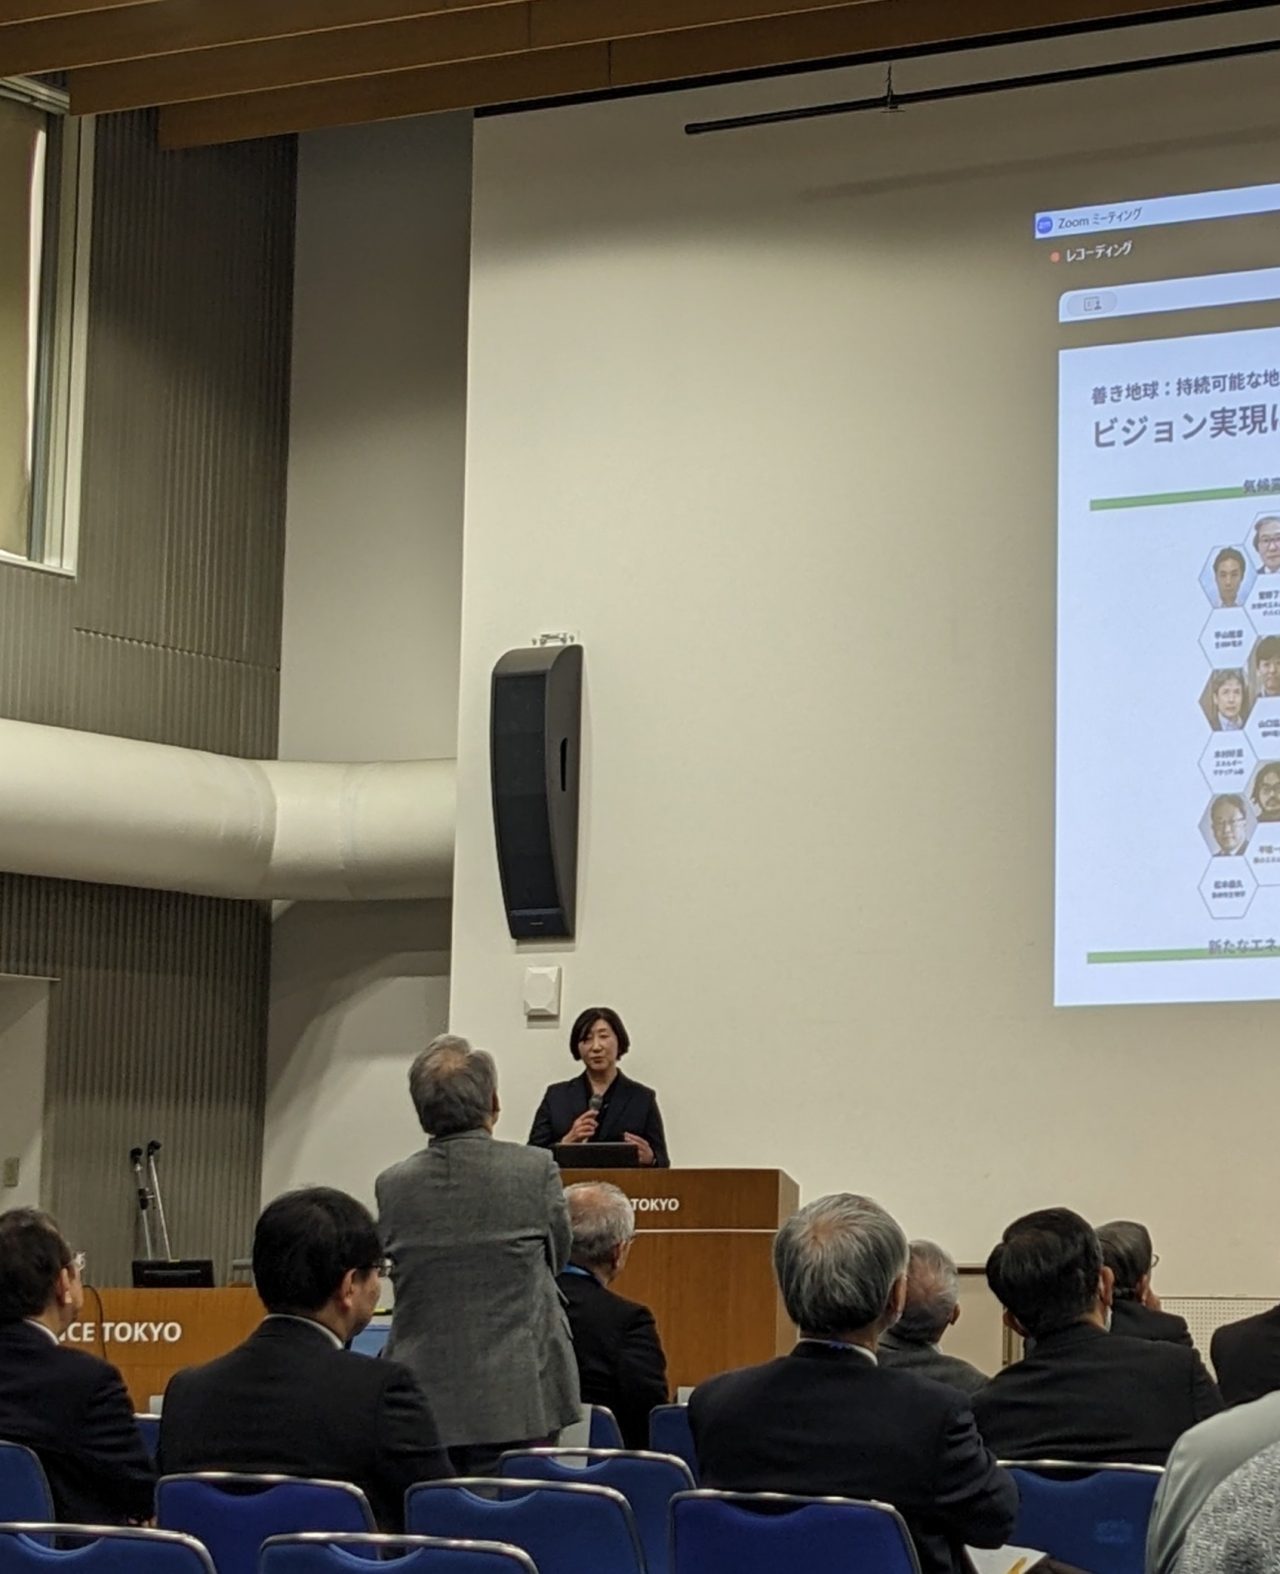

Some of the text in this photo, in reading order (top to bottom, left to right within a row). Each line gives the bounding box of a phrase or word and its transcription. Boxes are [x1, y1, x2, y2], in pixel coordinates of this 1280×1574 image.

[1058, 207, 1143, 229] Zoom ミーティング
[1066, 240, 1133, 262] レコーディング
[630, 1197, 680, 1212] TOKYO
[102, 1321, 182, 1342] TOKYO
